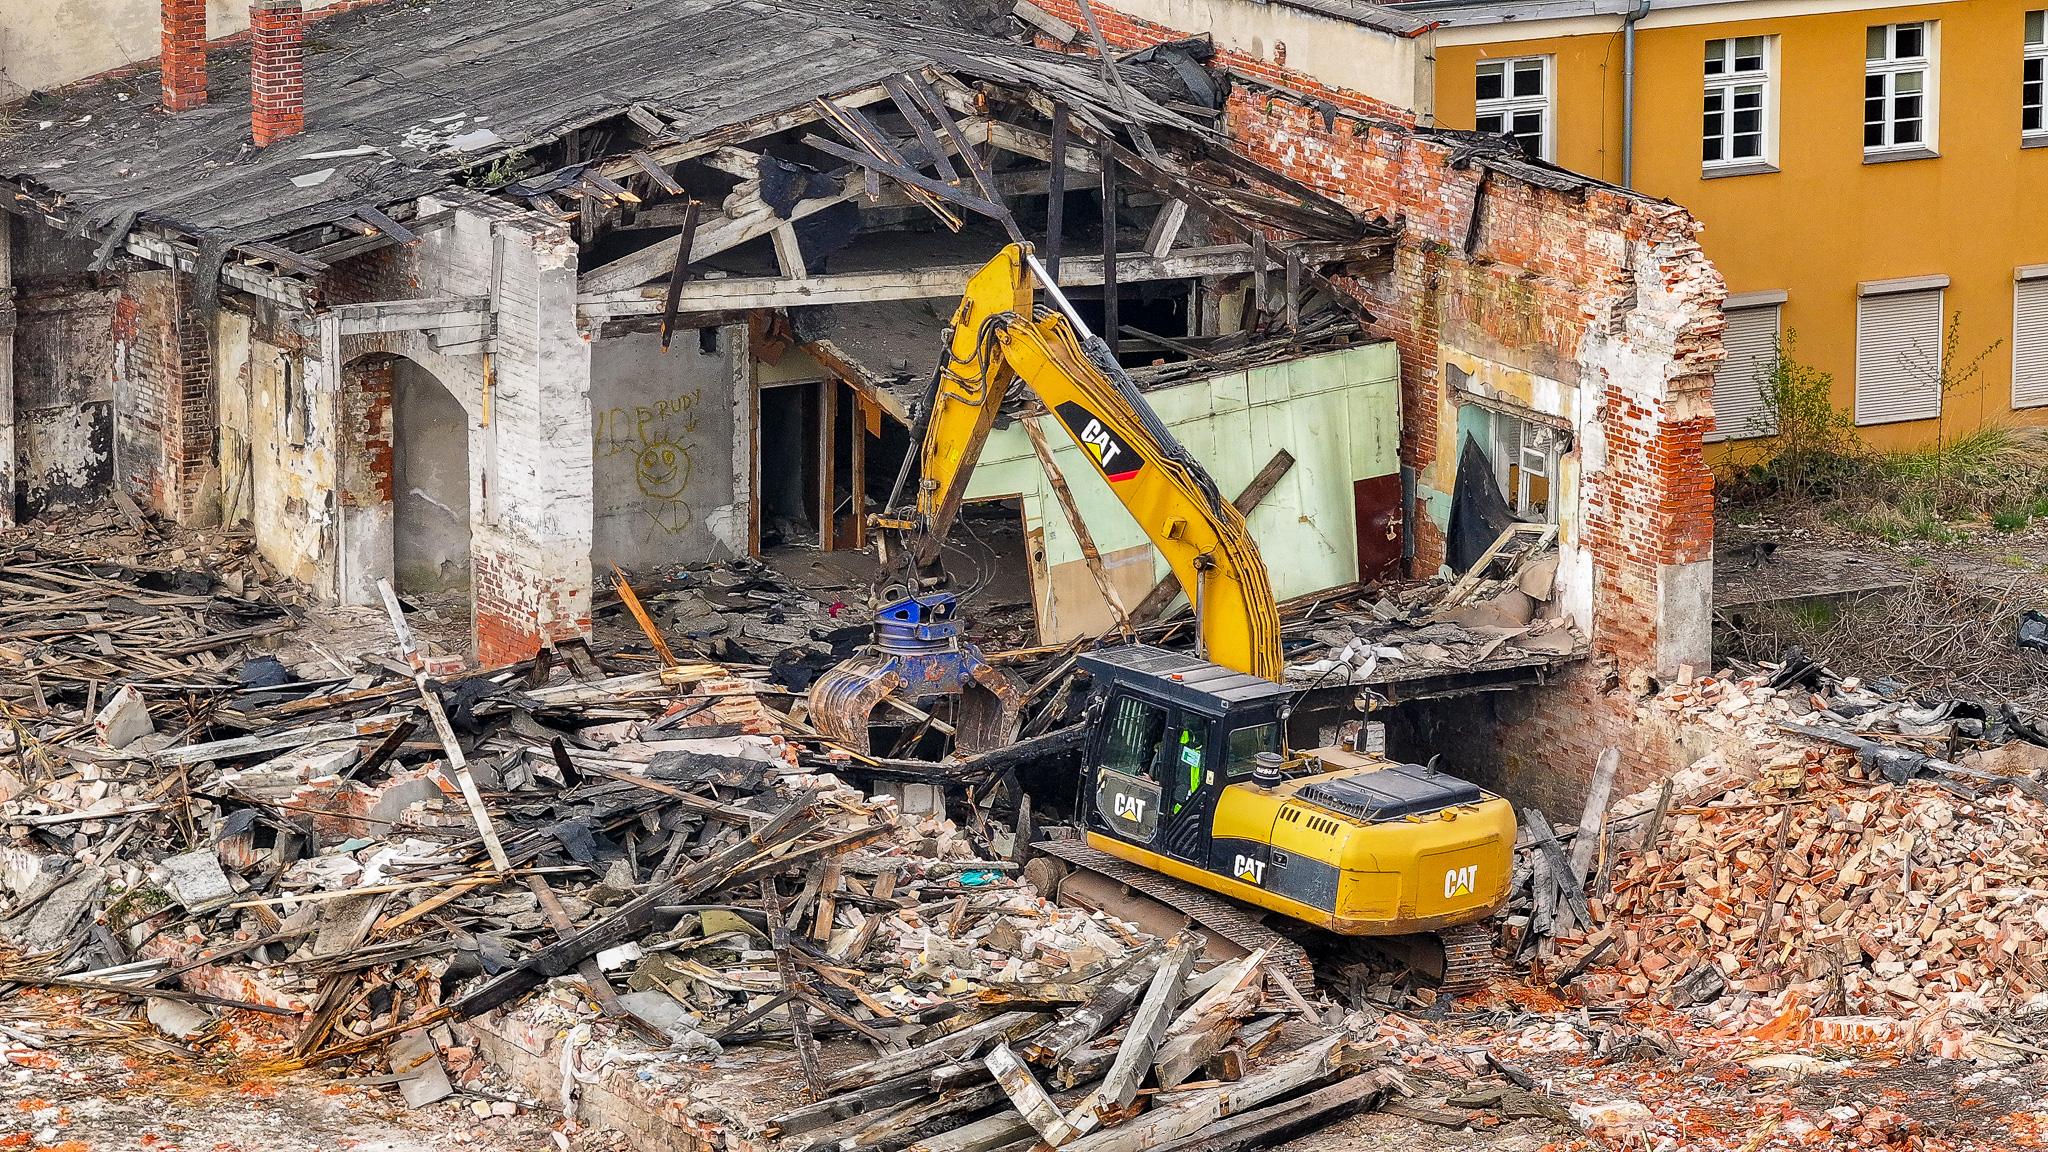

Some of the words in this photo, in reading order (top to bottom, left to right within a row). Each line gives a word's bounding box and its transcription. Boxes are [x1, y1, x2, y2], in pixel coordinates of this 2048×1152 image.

[1081, 418, 1121, 468] CAT
[1114, 792, 1146, 823] CAT
[1233, 854, 1265, 885] CAT
[1444, 865, 1478, 899] CAT
